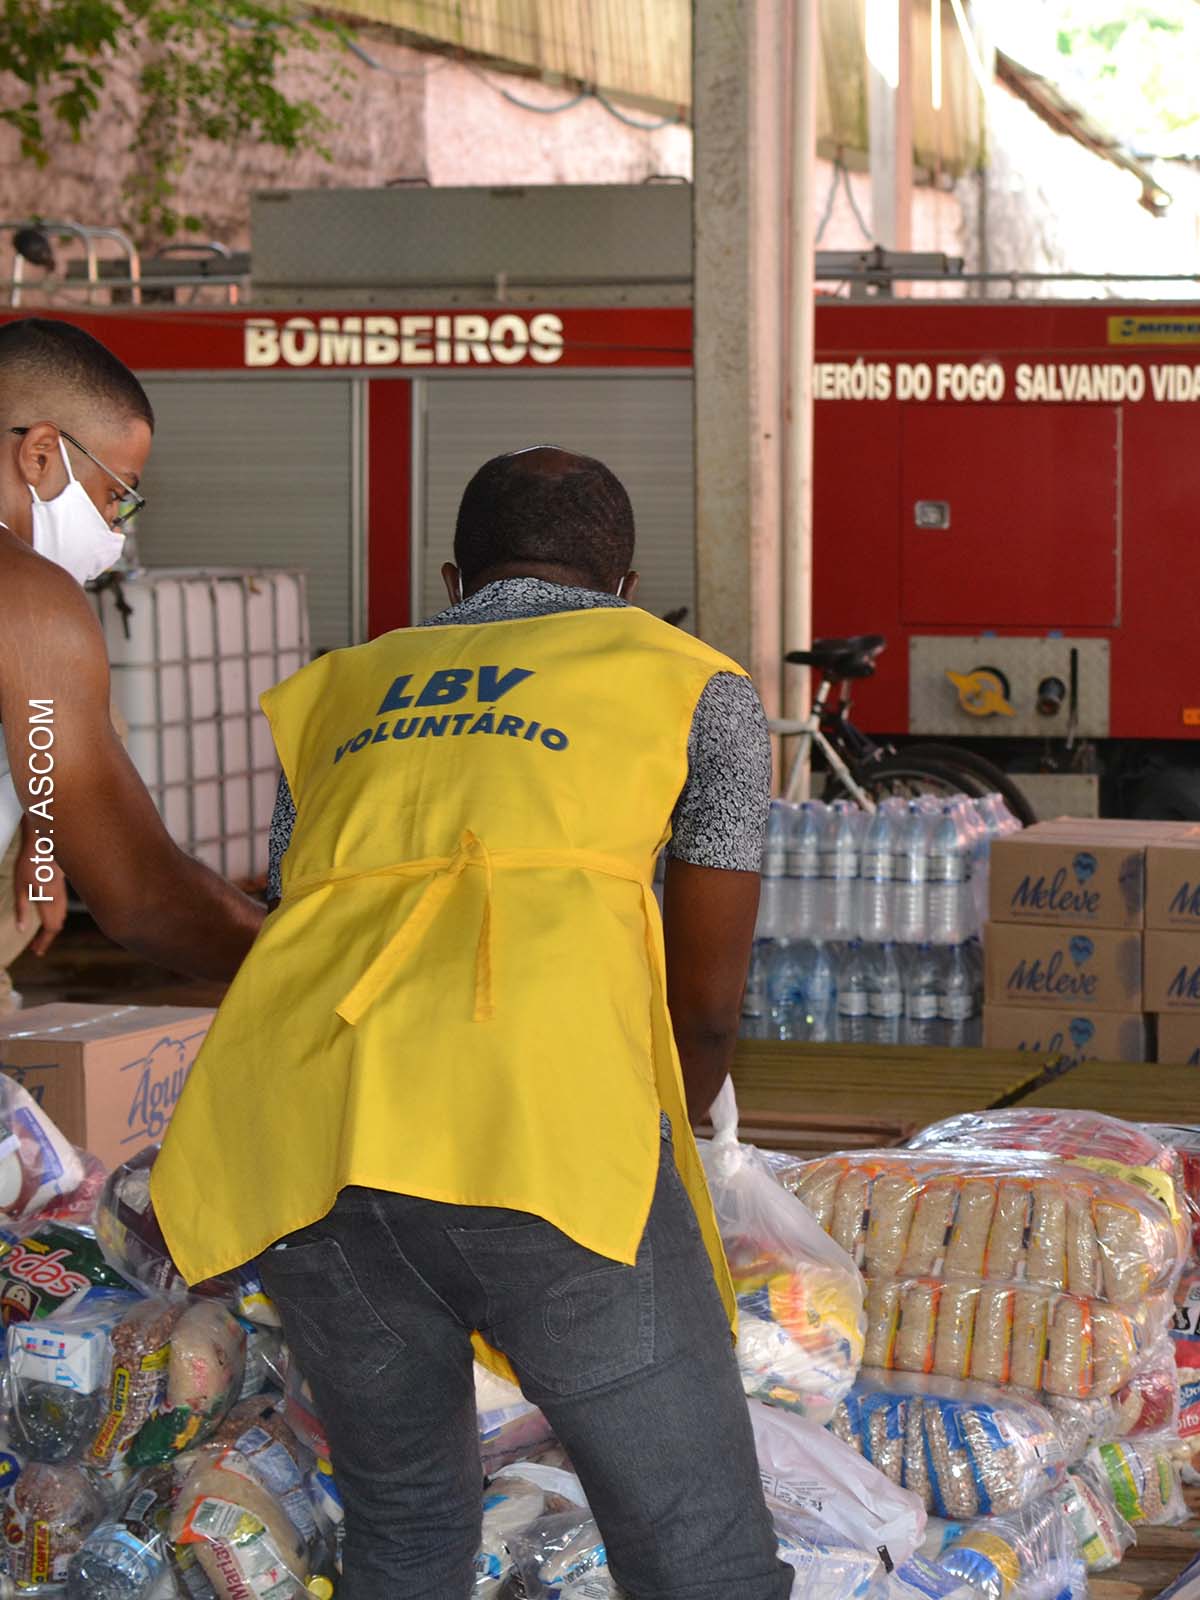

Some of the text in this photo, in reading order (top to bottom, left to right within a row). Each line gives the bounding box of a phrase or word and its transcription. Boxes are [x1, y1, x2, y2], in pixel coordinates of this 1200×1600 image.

[244, 313, 564, 367] BOMBEIROS
[896, 363, 931, 401] DO
[936, 363, 1005, 401] FOGO
[1015, 363, 1145, 402] SALVANDO
[376, 665, 536, 717] LBV
[333, 705, 570, 765] VOLUNTÁRIO
[1010, 867, 1101, 913] Meleve
[1006, 951, 1099, 995] Meleve
